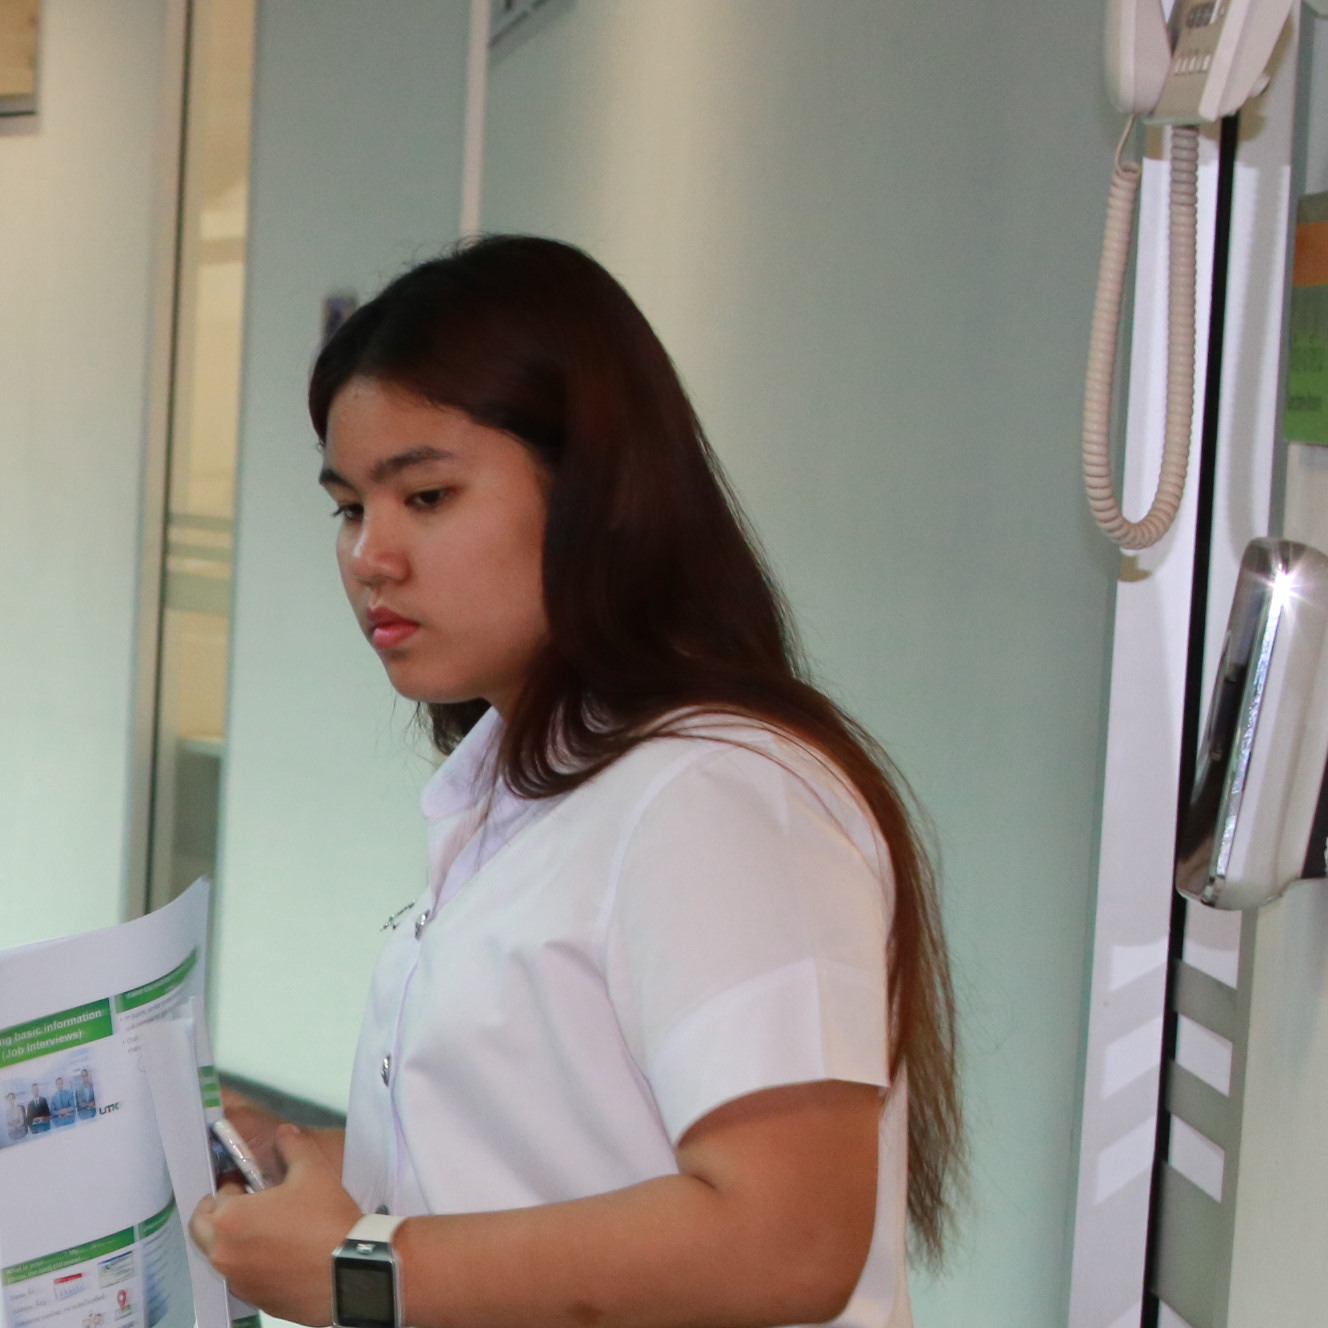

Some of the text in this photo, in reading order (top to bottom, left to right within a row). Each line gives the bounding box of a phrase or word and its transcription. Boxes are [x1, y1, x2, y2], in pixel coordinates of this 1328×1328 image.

[14, 1026, 42, 1042] basic
[44, 1009, 102, 1032] information
[1, 1043, 25, 1061] (Job
